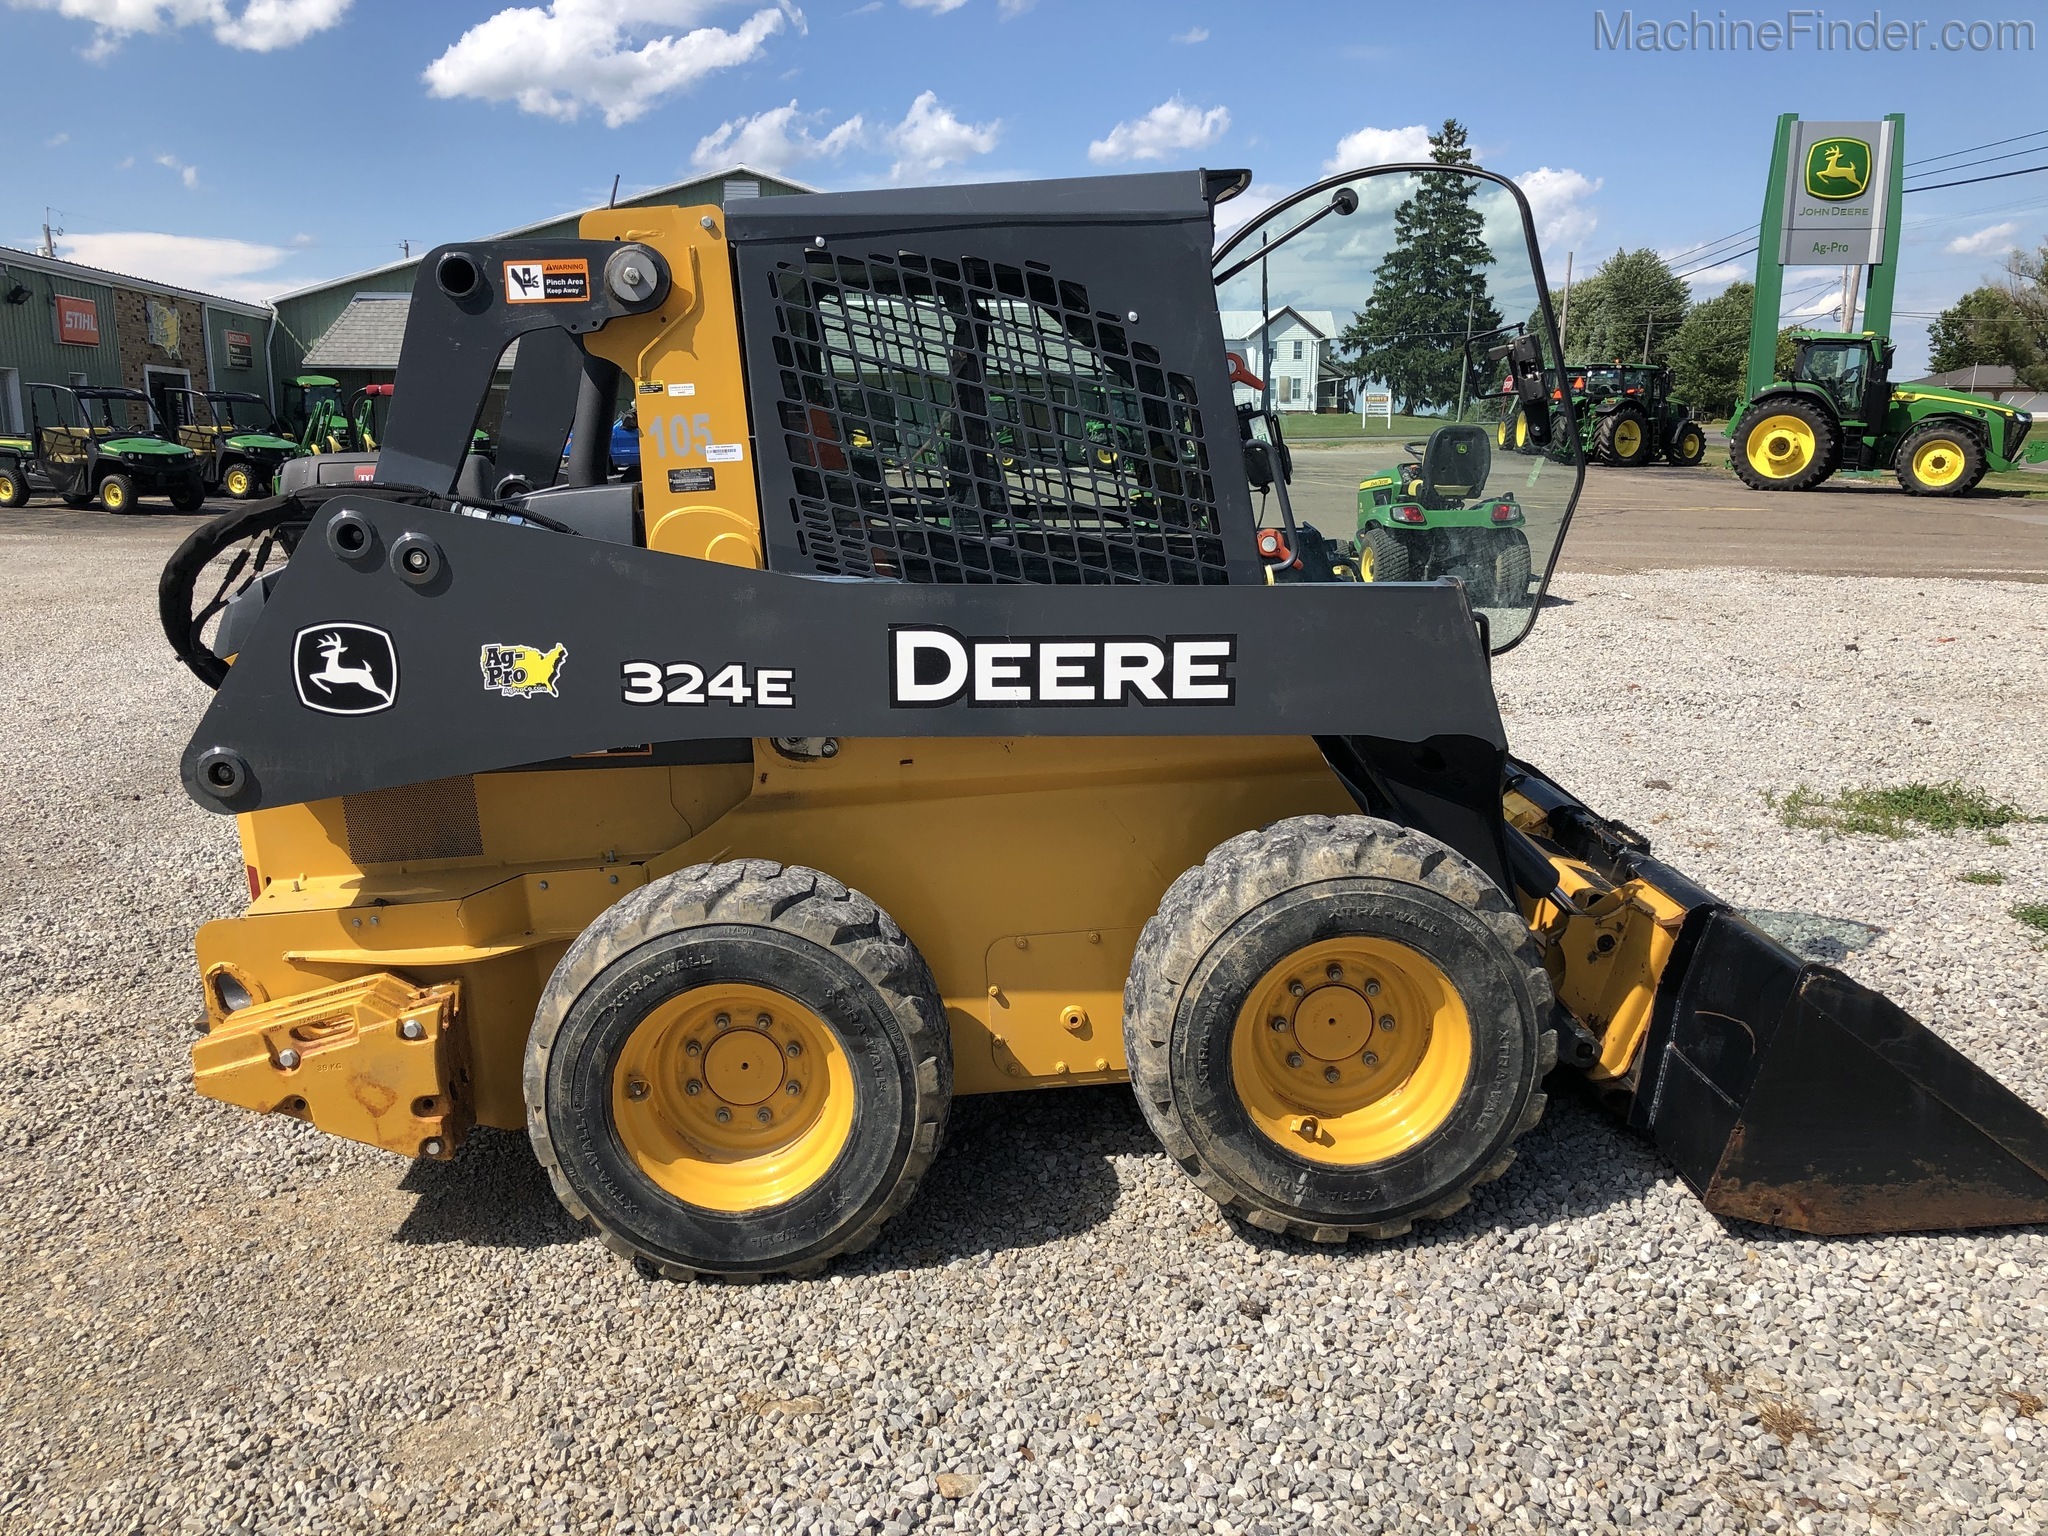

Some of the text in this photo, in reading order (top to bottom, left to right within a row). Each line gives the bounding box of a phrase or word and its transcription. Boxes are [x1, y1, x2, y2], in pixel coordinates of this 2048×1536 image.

[1799, 206, 1869, 216] JOHN DEERE
[1812, 242, 1849, 255] Ag-Pro
[65, 311, 98, 331] STIHL
[649, 413, 714, 458] 105
[486, 648, 524, 669] Ag-
[896, 631, 1230, 701] DEERE
[488, 667, 526, 686] Pro
[623, 662, 793, 705] 324E
[608, 954, 713, 1014] XTRA-WALL
